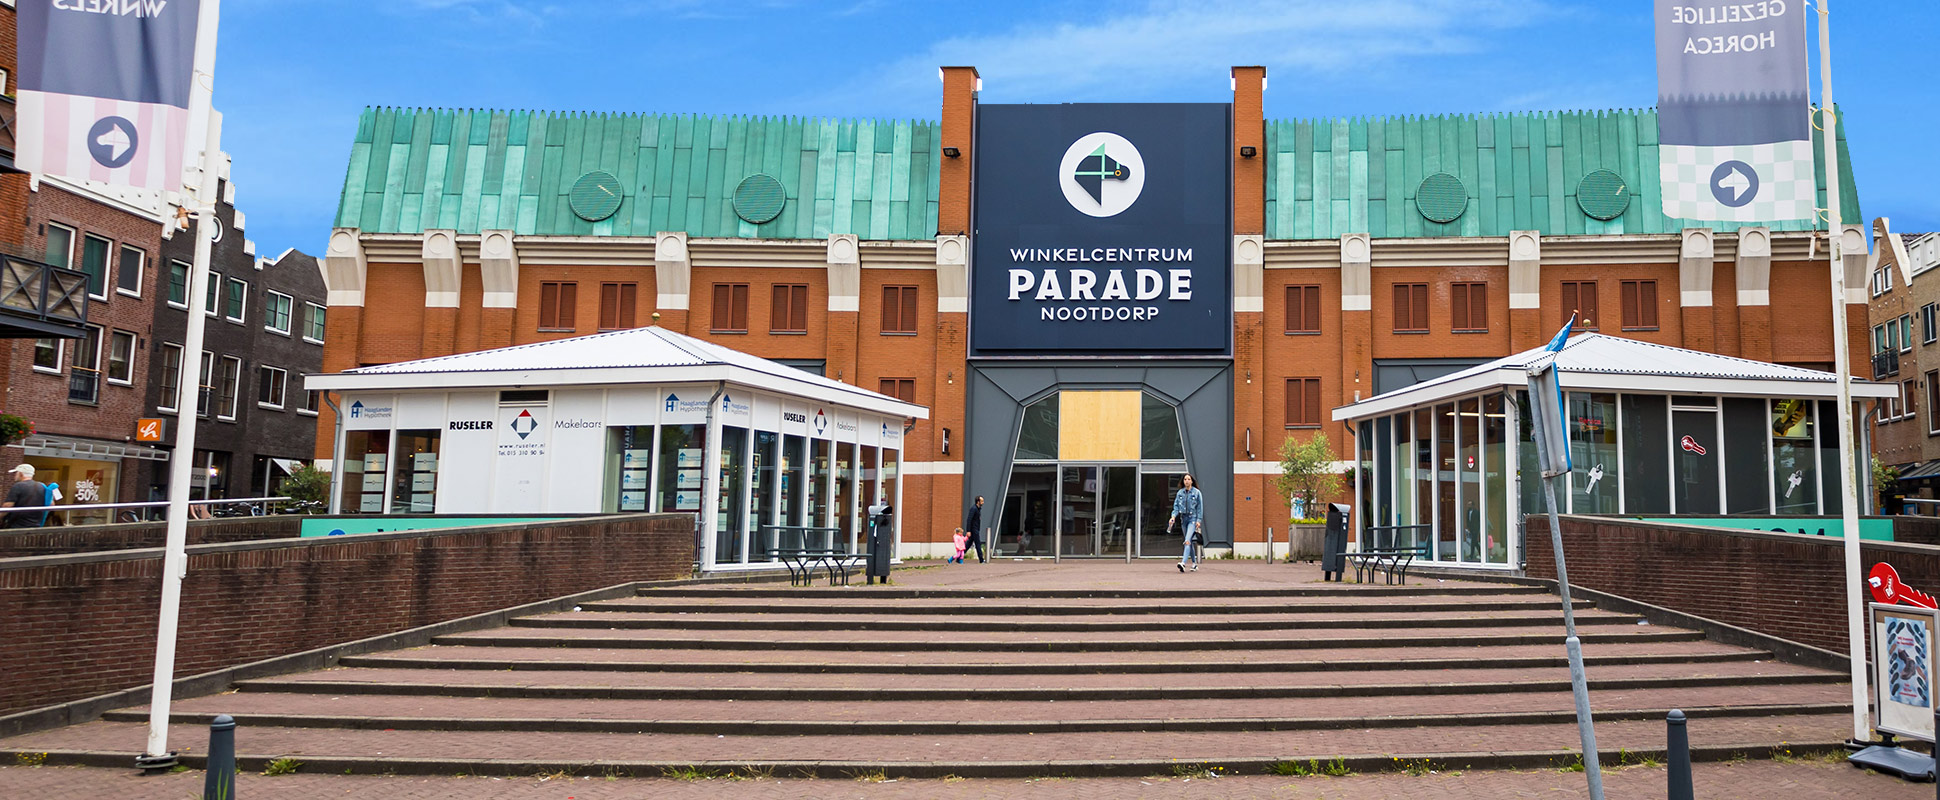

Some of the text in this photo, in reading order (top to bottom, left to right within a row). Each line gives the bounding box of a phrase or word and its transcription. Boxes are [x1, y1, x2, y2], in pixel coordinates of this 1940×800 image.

[1010, 248, 1193, 262] WINKELCENTRUM
[1008, 269, 1193, 301] PARADE
[1041, 306, 1159, 321] NOOTDORP
[449, 418, 602, 430] RUSELER Makelaars
[76, 480, 94, 489] sale
[75, 488, 99, 501] -50%
